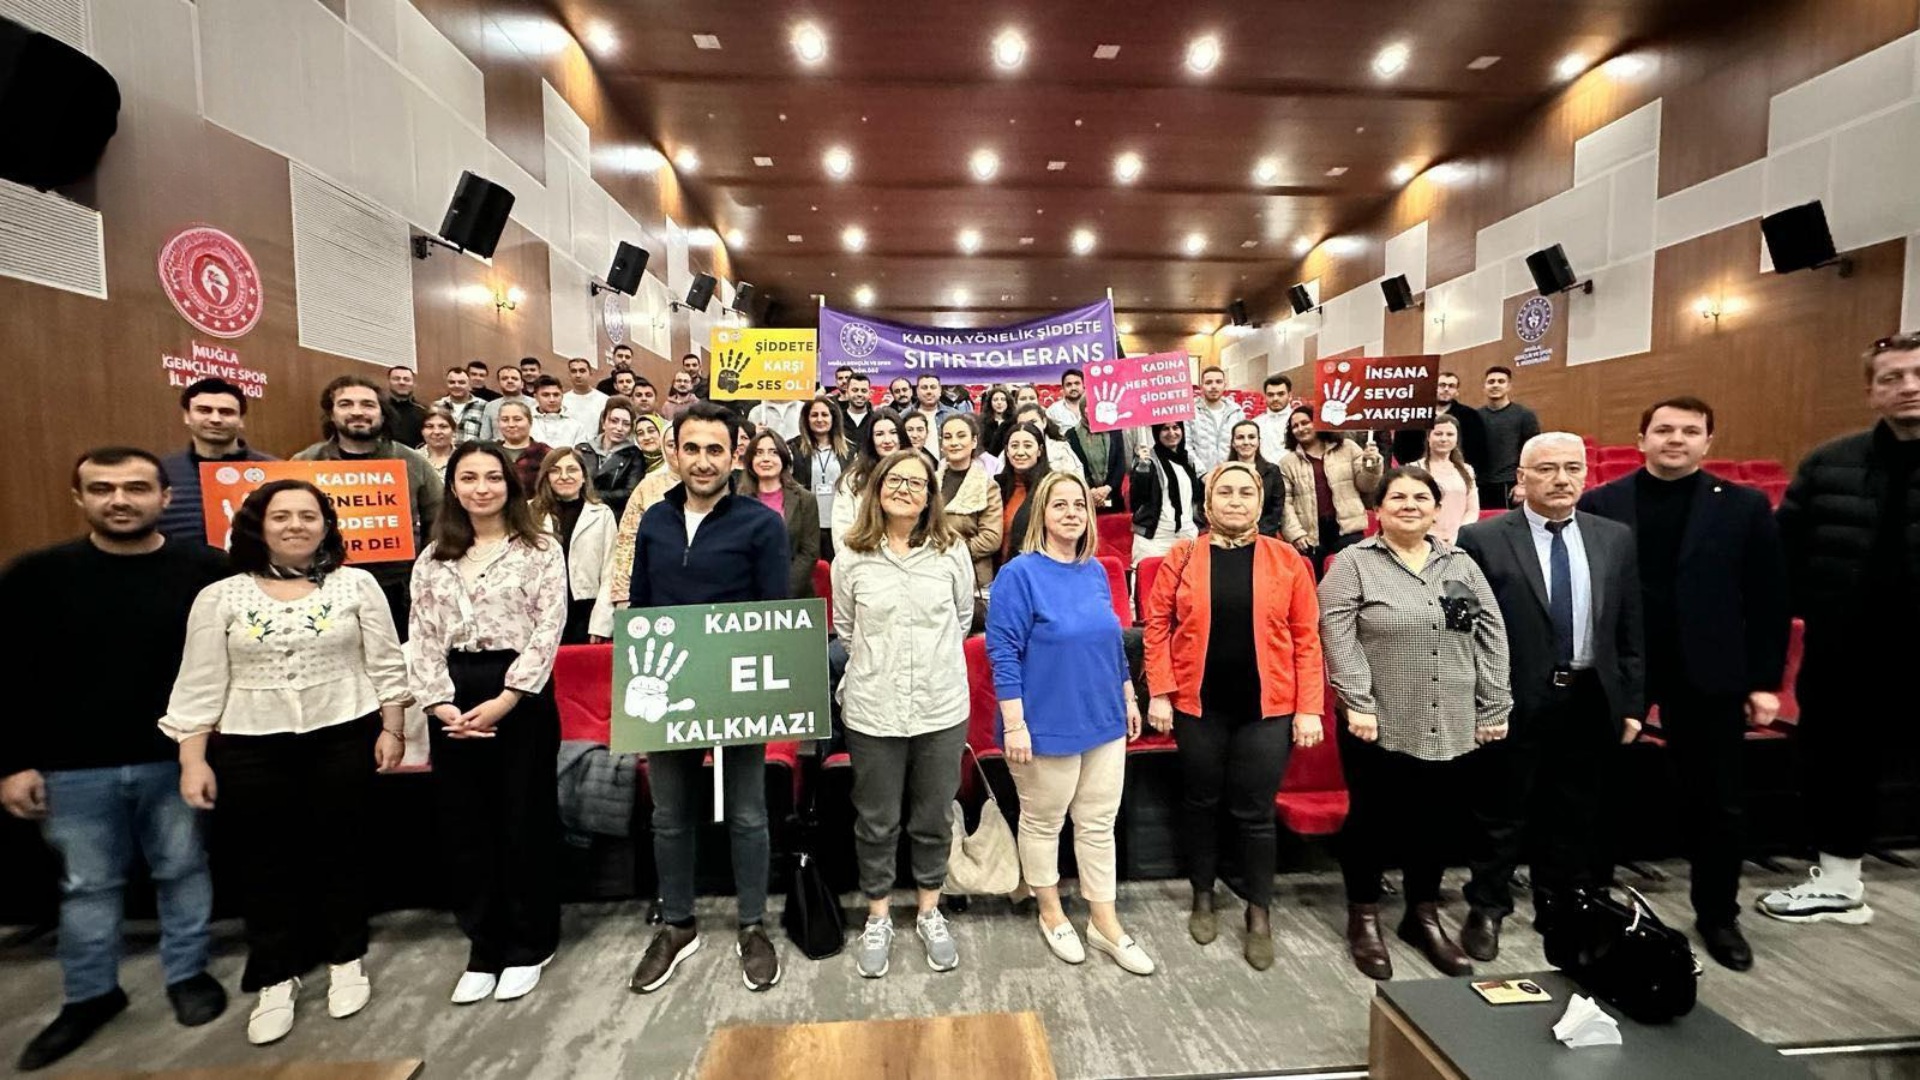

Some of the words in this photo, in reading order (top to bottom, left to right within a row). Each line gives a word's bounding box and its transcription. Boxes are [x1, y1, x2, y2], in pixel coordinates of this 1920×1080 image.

[902, 333, 963, 346] KADINA
[965, 329, 1034, 344] YÖNELİK
[1037, 320, 1102, 341] ŞİDDETE
[193, 343, 239, 364] MUĞLA
[755, 339, 814, 355] ŞİDDETE
[904, 349, 967, 369] SIFIR
[970, 342, 1105, 368] TOLERANS
[163, 356, 220, 376] GENÇLİK
[220, 366, 237, 379] VE
[238, 369, 268, 385] SPOR
[763, 360, 804, 374] KARŞI
[1141, 359, 1185, 373] KADINA
[1365, 365, 1429, 379] İNSANA
[756, 380, 782, 390] SES
[1125, 379, 1149, 390] HER
[1150, 372, 1187, 387] TÜRLÜ
[1140, 389, 1188, 405] ŞİDDETE
[1364, 384, 1414, 399] SEVGİ
[1363, 407, 1433, 423] YAKIŞIR!
[315, 471, 396, 487] KADINA
[324, 491, 397, 508] ÖNELİK
[337, 514, 399, 531] DDETE
[368, 536, 400, 551] DE!
[705, 608, 813, 634] KADINA
[731, 654, 790, 692] EL
[666, 711, 815, 744] KALKMAZ!
